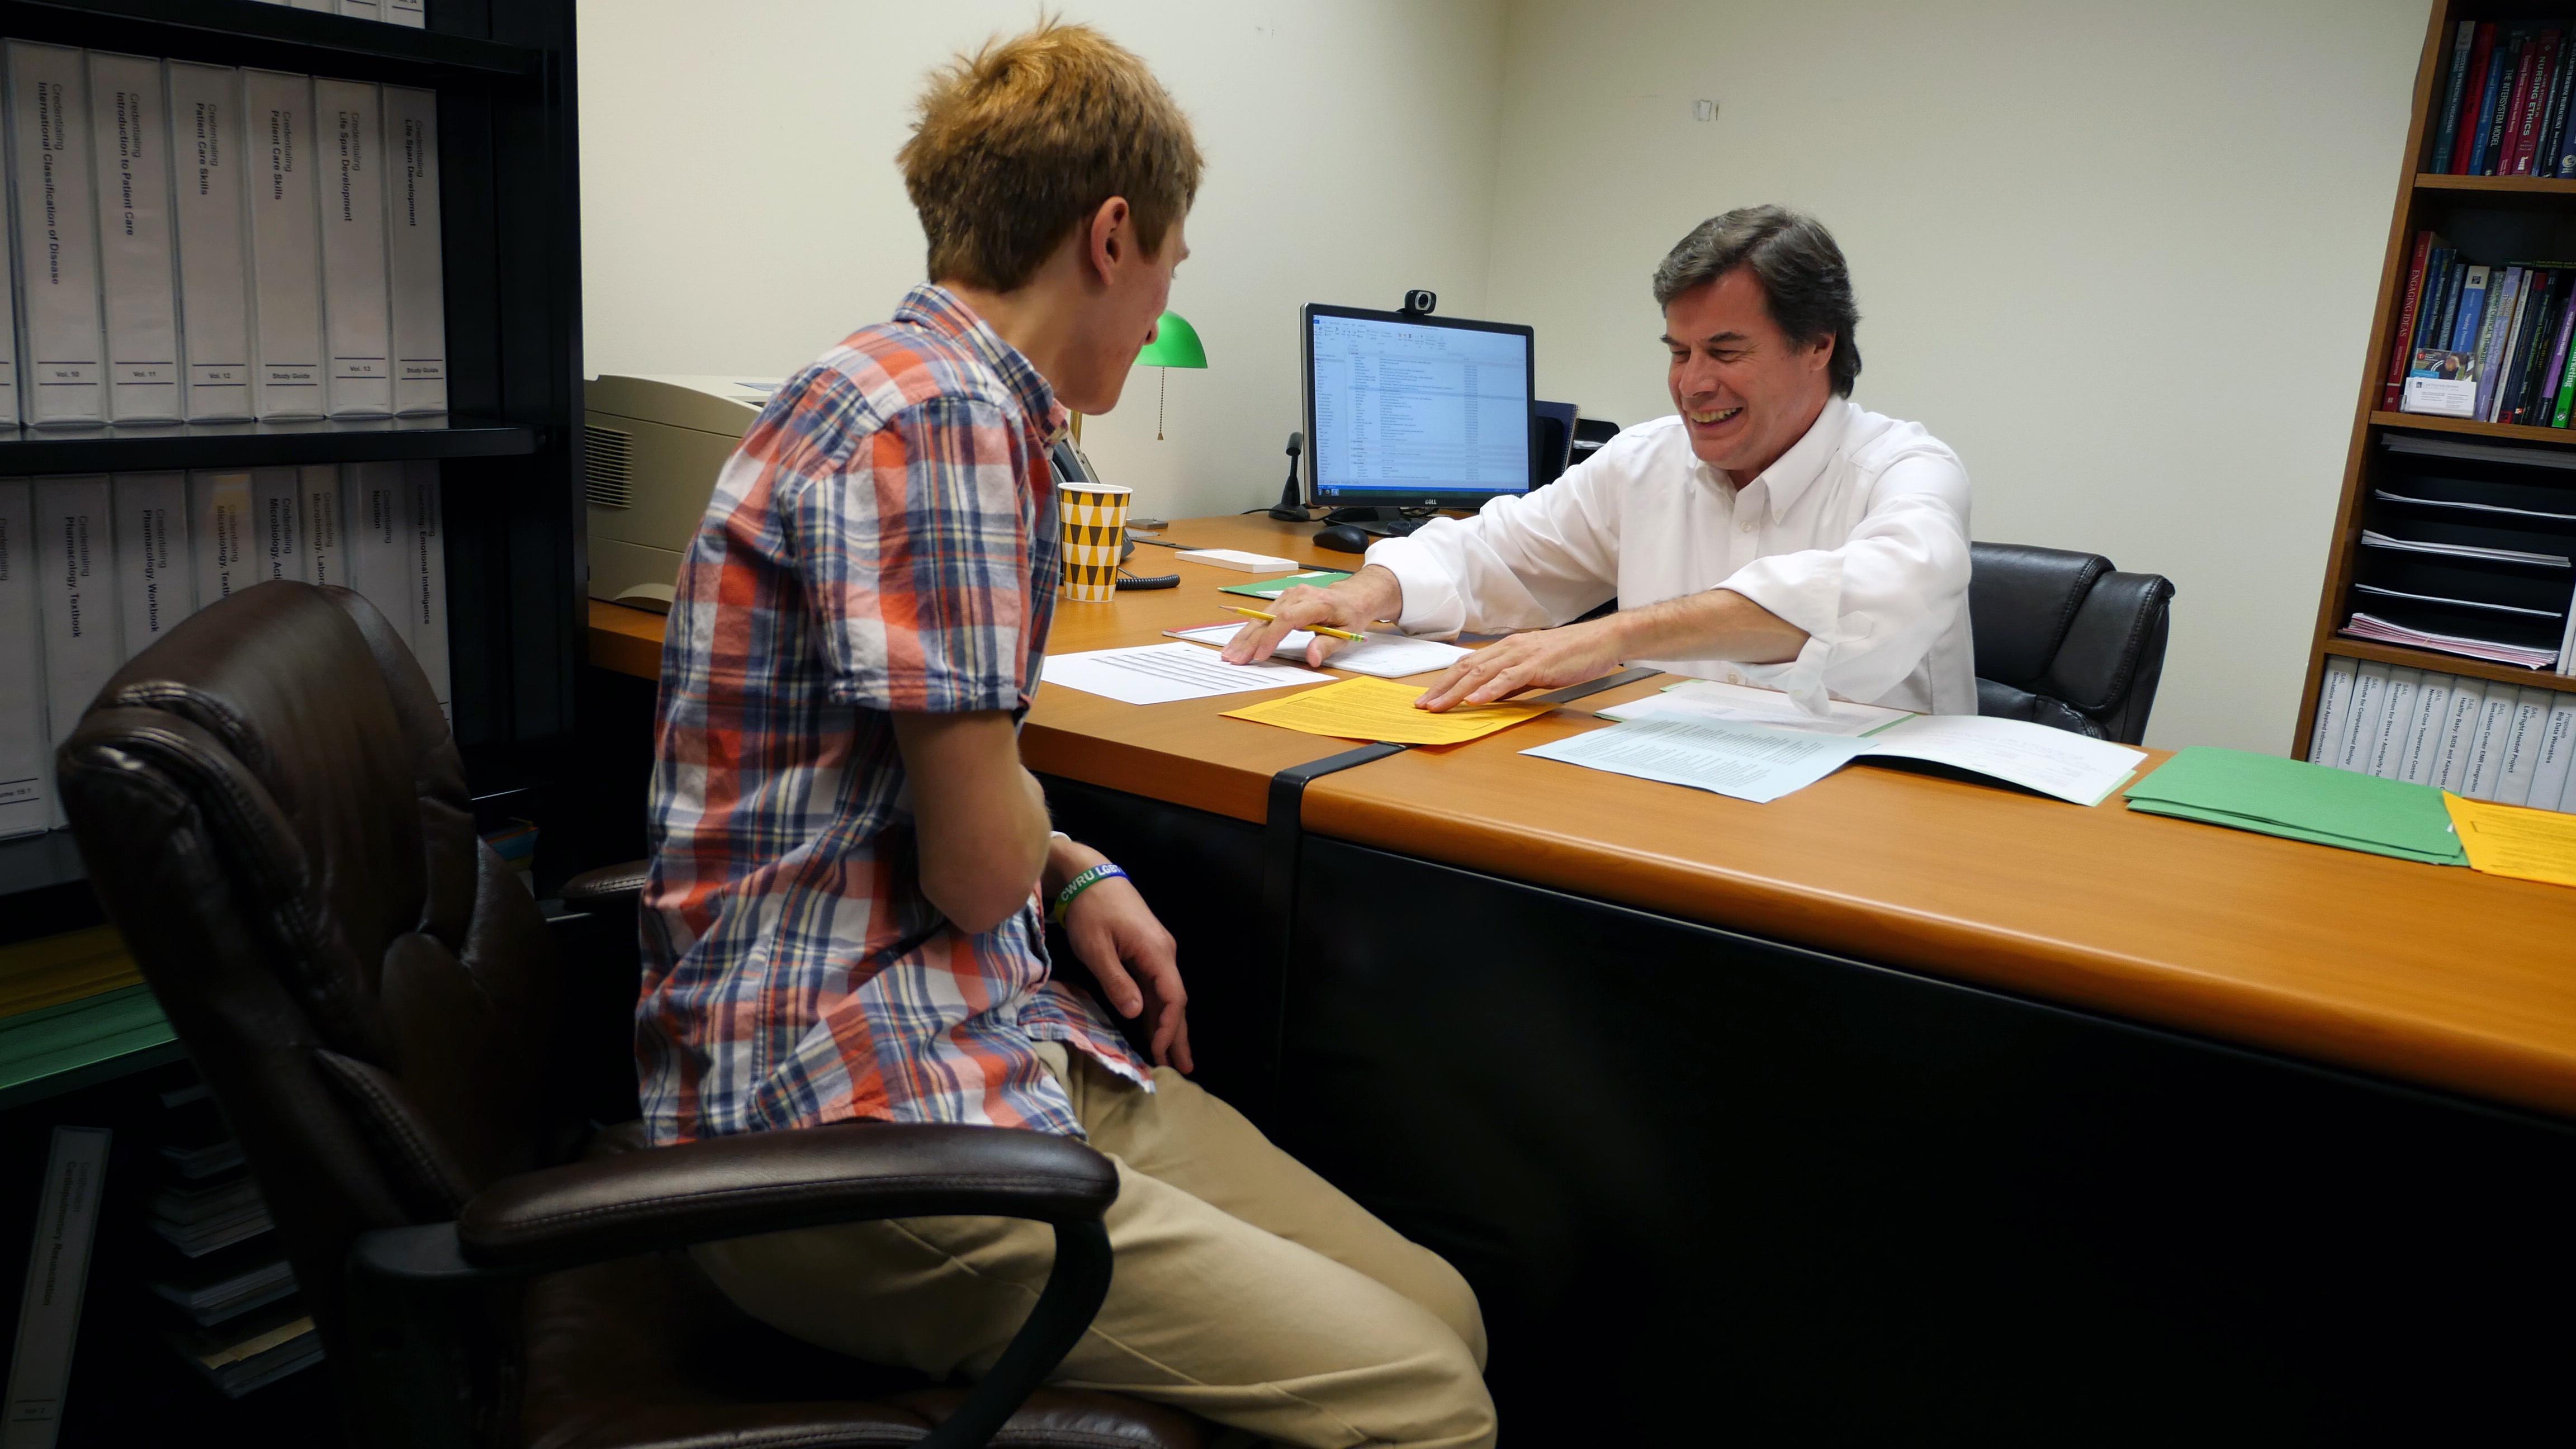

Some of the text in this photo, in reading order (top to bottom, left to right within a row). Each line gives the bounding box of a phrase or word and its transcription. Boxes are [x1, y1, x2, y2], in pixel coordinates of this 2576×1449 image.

[2490, 69, 2513, 147] THE INTERSYSTEM MODEL
[2523, 56, 2546, 136] NURSING ETHICS
[53, 84, 64, 150] Credentialing
[130, 93, 142, 158] Credentialing
[196, 103, 209, 195] Patient Care Skills
[207, 103, 219, 167] Credentialing
[282, 112, 292, 172] Credentialing
[351, 112, 362, 171] Credentialing
[405, 140, 414, 163] Span
[116, 92, 134, 235] Introduction to Patient Care
[272, 148, 281, 171] Care
[339, 112, 352, 221] Life Span Development
[39, 82, 59, 285] International Classification of Disease
[273, 174, 283, 200] Skills
[407, 166, 416, 226] Development
[2399, 270, 2420, 337] ENGAGING IDEAS
[2486, 310, 2497, 335] CRITICAL
[2562, 327, 2571, 342] Decision
[2557, 342, 2567, 356] Making
[217, 505, 227, 569] Microbiology,
[269, 498, 280, 559] Microbiology,
[282, 498, 292, 554] Credentialing
[312, 493, 322, 553] Microbiology,
[79, 516, 91, 576] Credentialing
[65, 517, 82, 638] Pharmacology, Textbook
[143, 510, 159, 633] Pharmacology, Workbook
[2329, 672, 2339, 699] Simulation
[2361, 676, 2371, 698] Institute
[2390, 683, 2402, 711] Simulation
[2425, 689, 2435, 712] Neonatal
[2322, 711, 2331, 730] Applied
[2456, 697, 2466, 718] Healthy
[2466, 698, 2474, 711] SAIL
[2497, 703, 2505, 716] SAIL
[2530, 707, 2538, 719] SAIL
[2351, 708, 2364, 745] Computational
[2384, 720, 2393, 737] Stress
[2508, 705, 2530, 773] LifeFlight Handoff Project
[2546, 712, 2564, 764] Big Data Wearables
[2560, 713, 2573, 738] Proposals
[2316, 731, 2326, 760] Informatics
[2346, 745, 2355, 765] Biology
[2376, 742, 2388, 768] Ambiguity
[2414, 727, 2426, 760] Temperature
[2470, 702, 2497, 792] Simulation Center EMR Integration
[2409, 760, 2418, 779] Control
[2441, 760, 2452, 788] Kangaroo
[1061, 870, 1095, 901] CWRU
